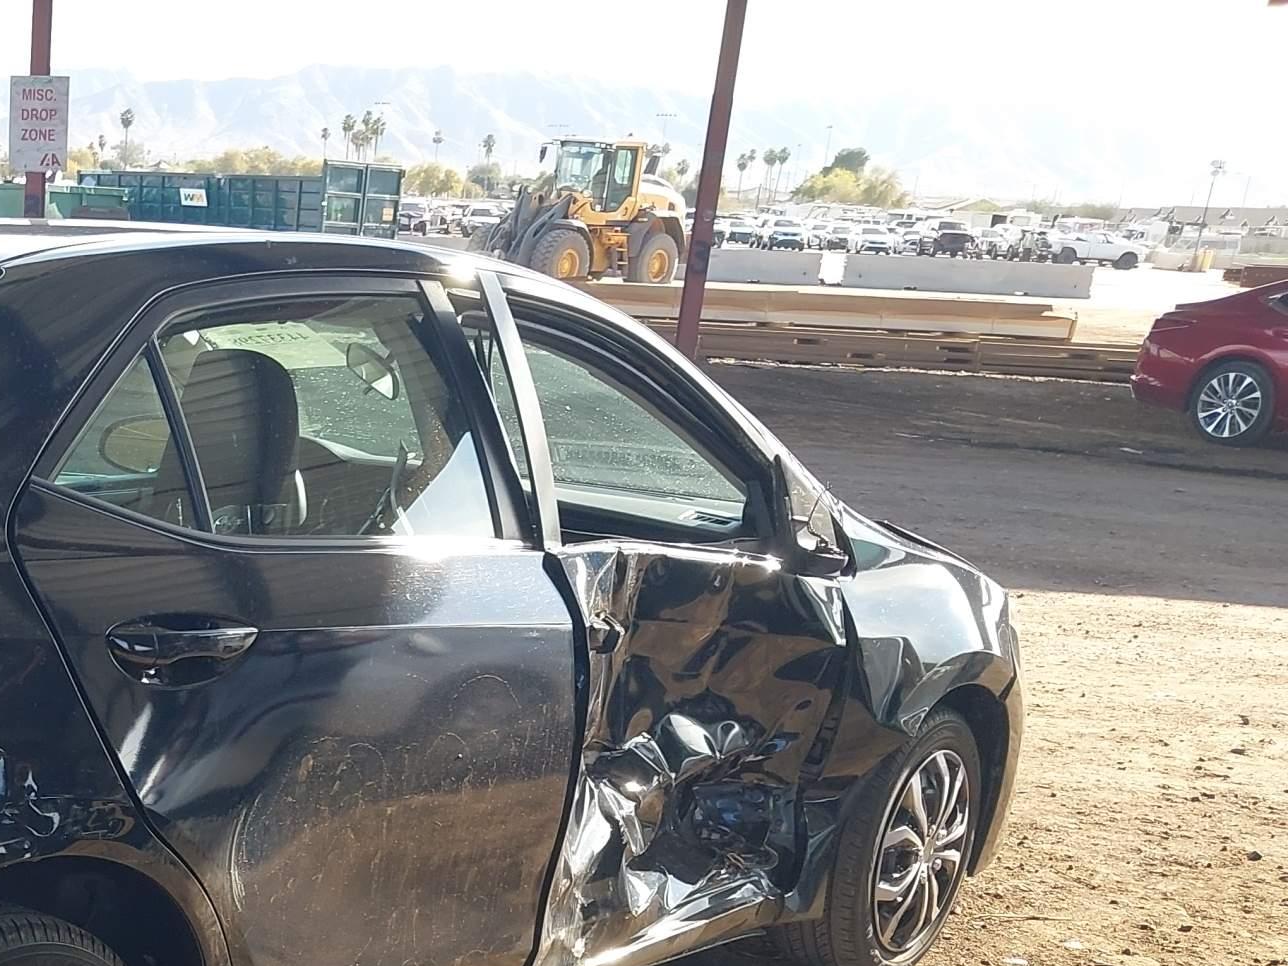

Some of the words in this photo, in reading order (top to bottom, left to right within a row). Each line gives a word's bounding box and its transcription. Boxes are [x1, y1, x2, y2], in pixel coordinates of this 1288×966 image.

[22, 88, 57, 102] MISC.
[21, 108, 57, 121] DROP
[21, 128, 56, 141] ZONE
